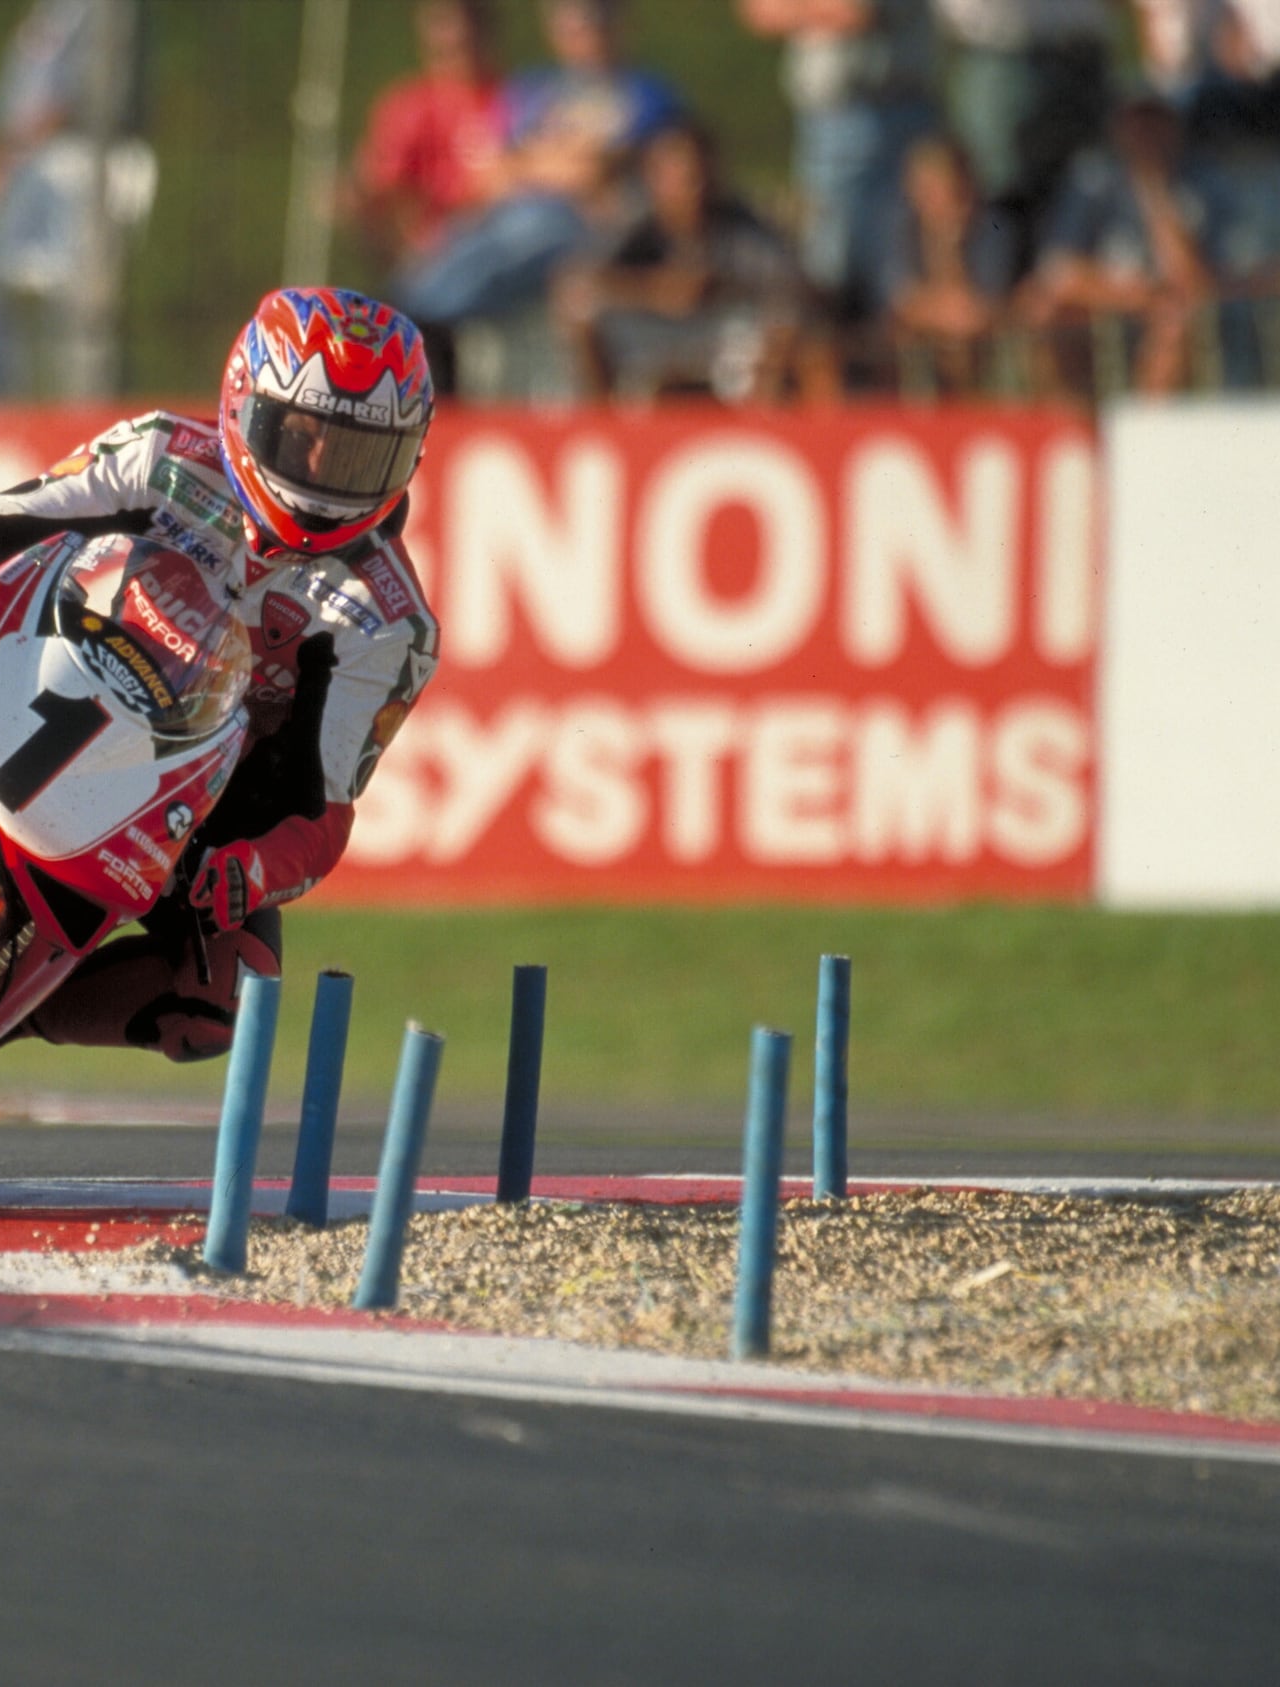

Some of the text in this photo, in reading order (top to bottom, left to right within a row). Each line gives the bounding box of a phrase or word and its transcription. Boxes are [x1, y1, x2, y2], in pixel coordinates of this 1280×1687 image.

[303, 388, 388, 422] SHARK
[175, 429, 221, 460] DIES
[361, 555, 410, 614] DIESEL
[104, 636, 173, 709] ADVANCE
[98, 848, 154, 901] FORTIS
